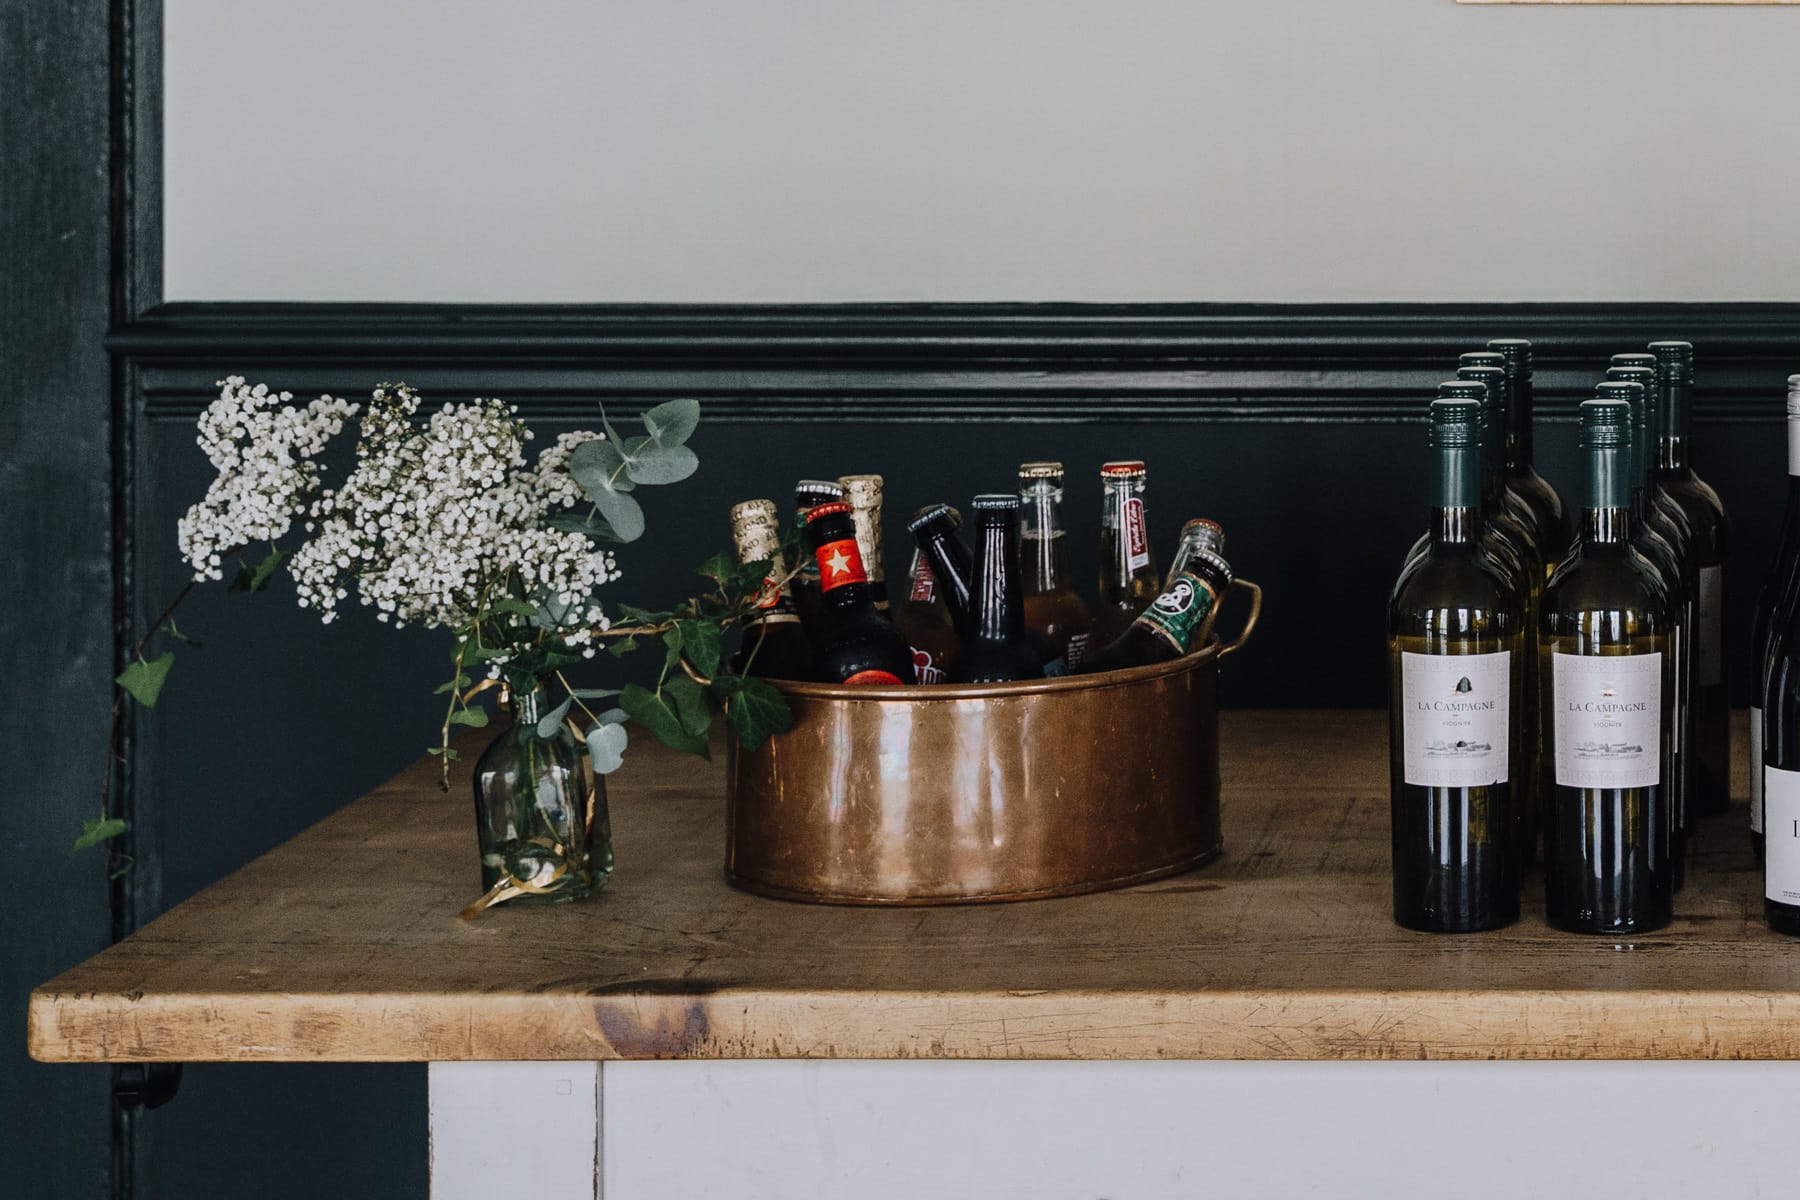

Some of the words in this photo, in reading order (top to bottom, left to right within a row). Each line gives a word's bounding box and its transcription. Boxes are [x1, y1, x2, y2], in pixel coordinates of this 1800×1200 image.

[1418, 701, 1431, 711] LA
[1434, 700, 1495, 712] CAMPAGNE
[1569, 702, 1581, 712] LA
[1585, 702, 1647, 713] CAMPAGNE
